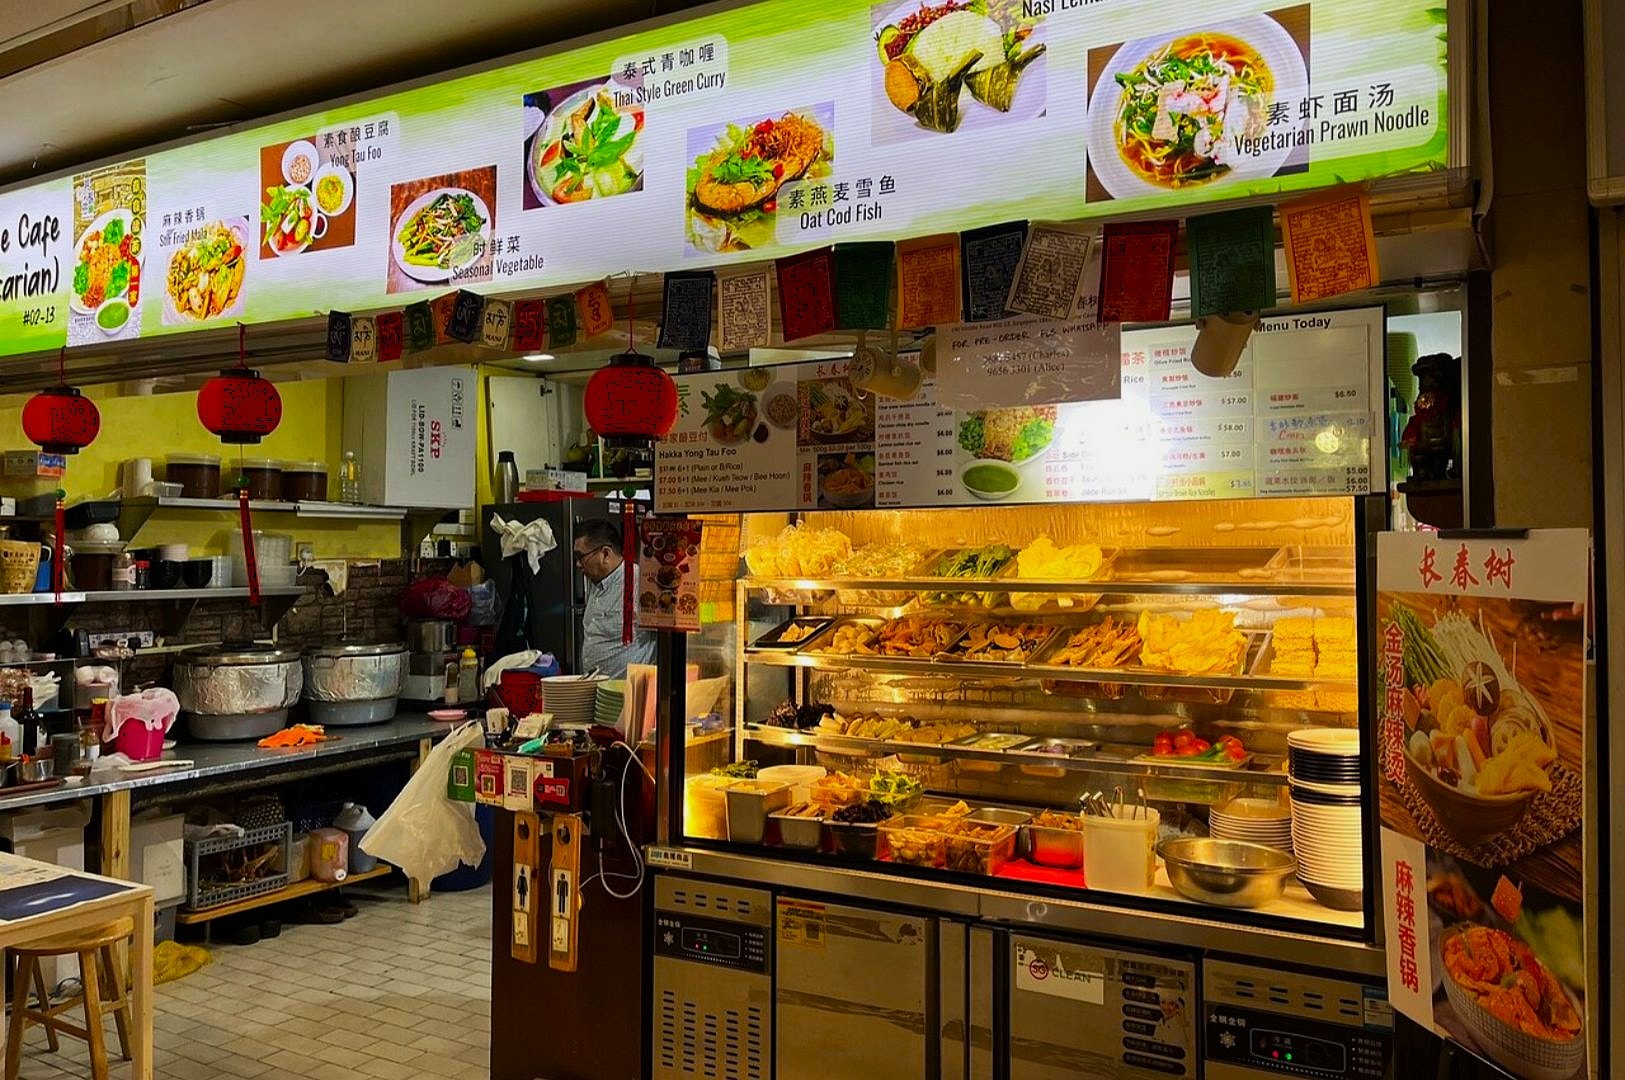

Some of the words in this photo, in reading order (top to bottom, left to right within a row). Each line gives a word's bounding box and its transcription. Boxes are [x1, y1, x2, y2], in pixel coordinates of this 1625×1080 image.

[623, 43, 714, 80] 泰式青咖喱
[614, 89, 633, 108] Thai
[636, 84, 661, 103] Style
[664, 79, 694, 97] Green
[697, 72, 726, 90] Curry
[1266, 83, 1394, 127] 素虾面汤
[324, 120, 389, 149] 素食酿豆腐
[1235, 126, 1314, 157] Vegetarian
[1320, 119, 1368, 142] Prawn
[1374, 105, 1429, 134] Noodle
[330, 153, 350, 168] Yong
[352, 149, 365, 163] Tau
[367, 145, 382, 160] Foo
[789, 175, 896, 209] 素燕麦雪鱼
[800, 211, 821, 230] Oat
[827, 206, 851, 225] Cod
[856, 201, 882, 222] Fish
[18, 213, 60, 257] Cafe
[173, 229, 190, 245] Fried
[473, 235, 520, 258] 时鲜菜
[452, 261, 493, 280] Seasonal
[496, 254, 544, 276] Vegetable
[23, 306, 56, 326] #02-13
[1256, 319, 1289, 332] Menu
[1292, 317, 1331, 329] Today
[952, 341, 969, 350] FOR
[1124, 375, 1144, 384] Rice
[1335, 390, 1357, 398] $6.50
[430, 420, 441, 459] SKP
[659, 450, 683, 459] Hakka
[684, 448, 704, 459] Yong
[706, 448, 720, 457] Tau
[721, 447, 737, 456] Foo
[754, 472, 768, 480] Bee
[769, 471, 791, 481] Hoon)
[1418, 543, 1516, 591] 长春树
[1051, 967, 1092, 984] CLEAN
